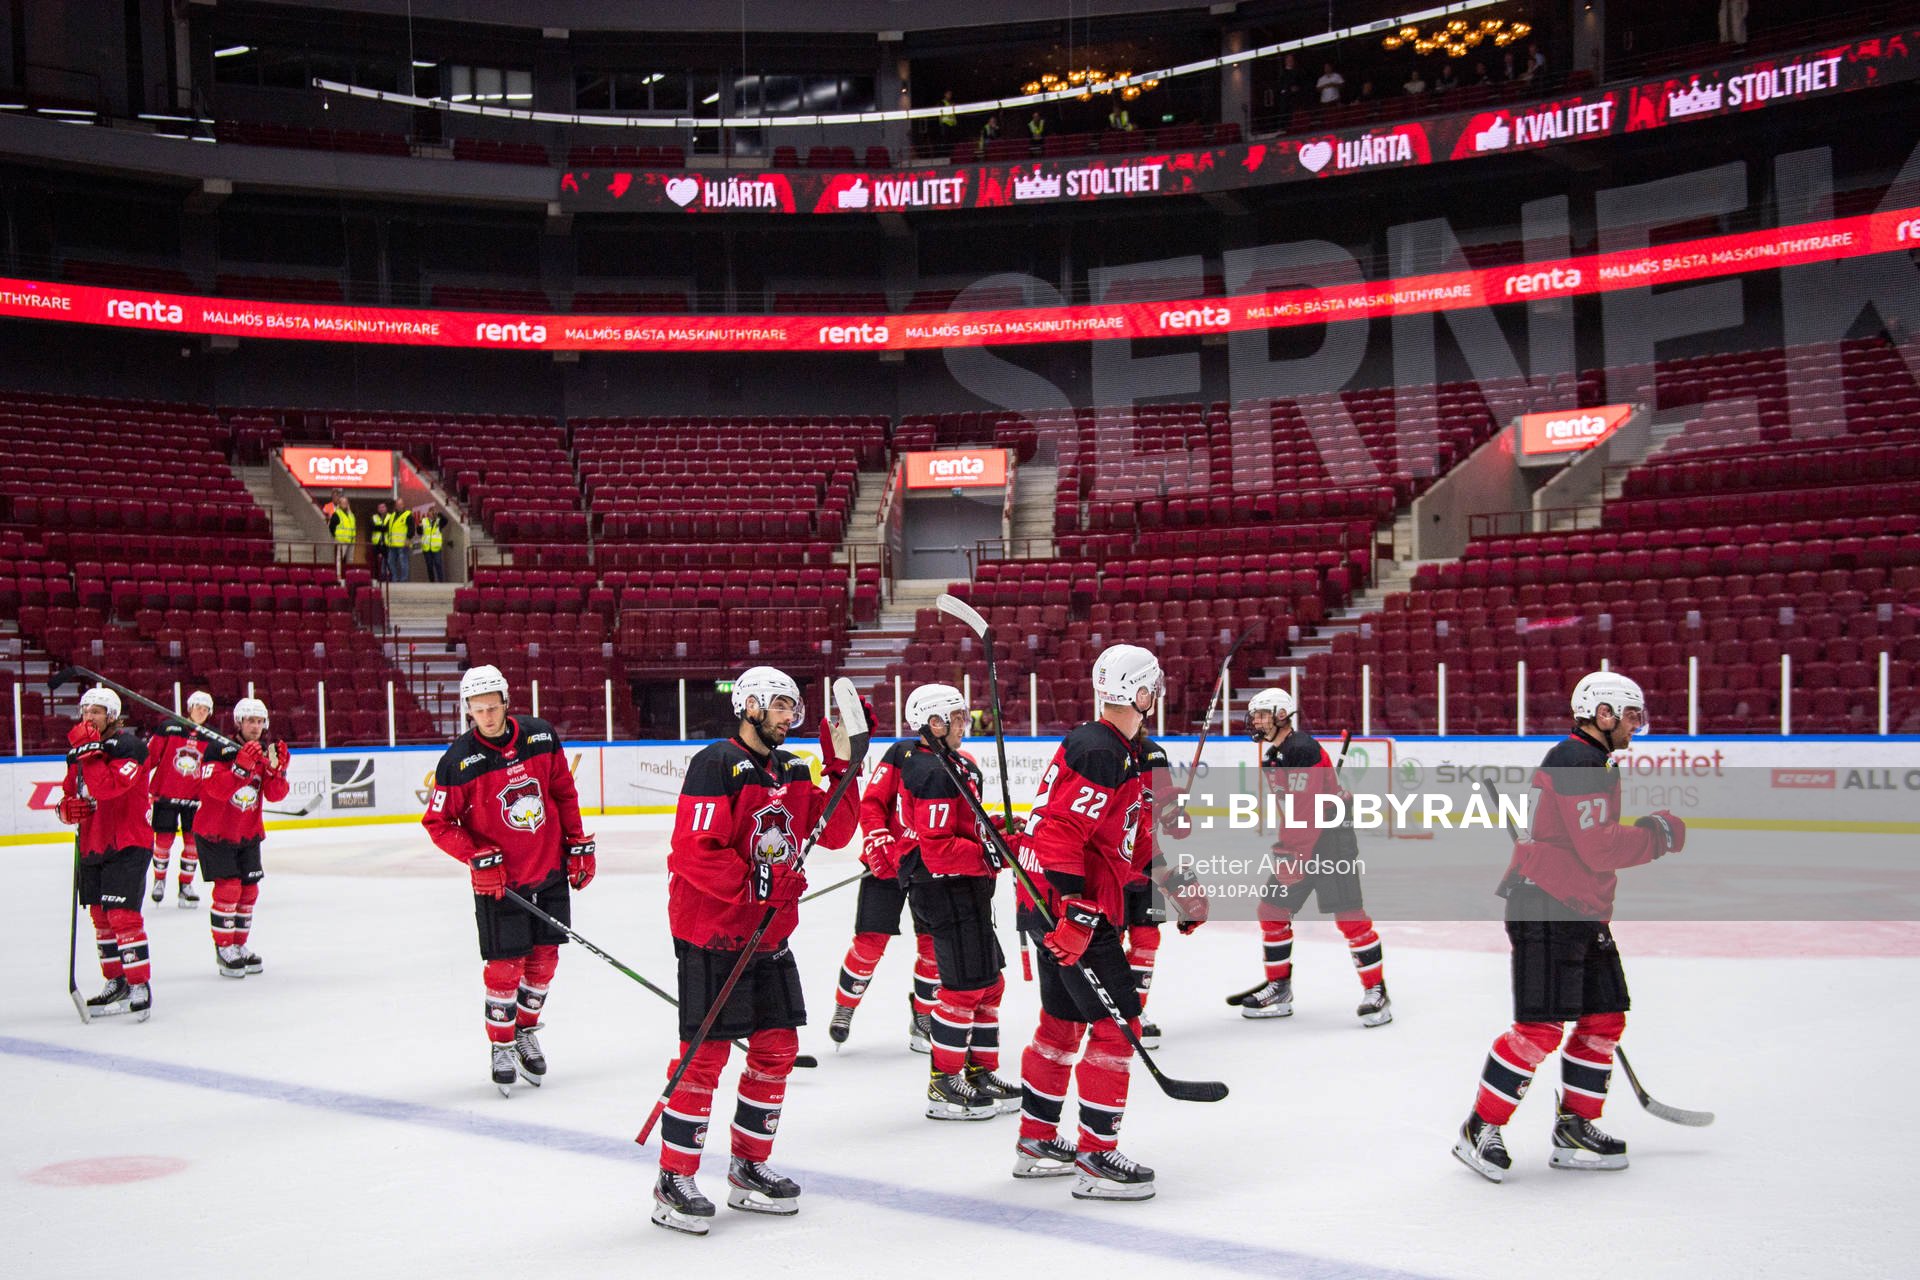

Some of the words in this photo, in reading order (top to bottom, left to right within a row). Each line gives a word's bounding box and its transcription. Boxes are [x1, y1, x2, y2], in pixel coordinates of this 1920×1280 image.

[1727, 56, 1842, 107] STOLTHET
[1515, 100, 1613, 146] KVALITET
[1336, 132, 1412, 169] HJÄRTA
[874, 178, 963, 206] KVALITET
[1066, 164, 1163, 196] STOLTHET
[704, 180, 777, 208] HJÄRTA
[1600, 256, 1659, 280] MALMÖS
[1662, 251, 1709, 272] BÄSTA
[1711, 231, 1854, 264] MASKINUTHYRARE
[1504, 265, 1582, 296] renta
[0, 290, 72, 311] THYRARE
[107, 299, 184, 324] renta
[1304, 296, 1345, 314] BÄSTA
[1347, 283, 1472, 309] MASKINUTHYRARE
[202, 310, 263, 327] MALMÖS
[266, 312, 311, 330] BÄSTA
[313, 317, 441, 336] MASKINUTHYRARE
[905, 323, 960, 339] MALMÖS
[962, 320, 1003, 337] BÄSTA
[1005, 316, 1125, 334] MASKINUTHYRARE
[1159, 305, 1231, 329] renta
[476, 322, 547, 343] renta
[565, 326, 621, 341] MALMÖS
[624, 327, 665, 341] BÄSTA
[668, 327, 788, 341] MASKINUTHYRARE
[819, 323, 889, 344] renta
[1545, 415, 1606, 439] renta
[308, 454, 369, 475] renta
[928, 456, 985, 475] renta
[982, 756, 1000, 768] Nä
[1436, 760, 1534, 784] ŠKOD
[1607, 748, 1725, 778] rioritet
[1843, 769, 1898, 790] ALL
[432, 789, 447, 813] 9
[1071, 786, 1109, 821] 22
[1576, 798, 1607, 830] 27
[692, 802, 716, 831] 11
[928, 803, 950, 829] 17
[1083, 967, 1129, 1026] CCM
